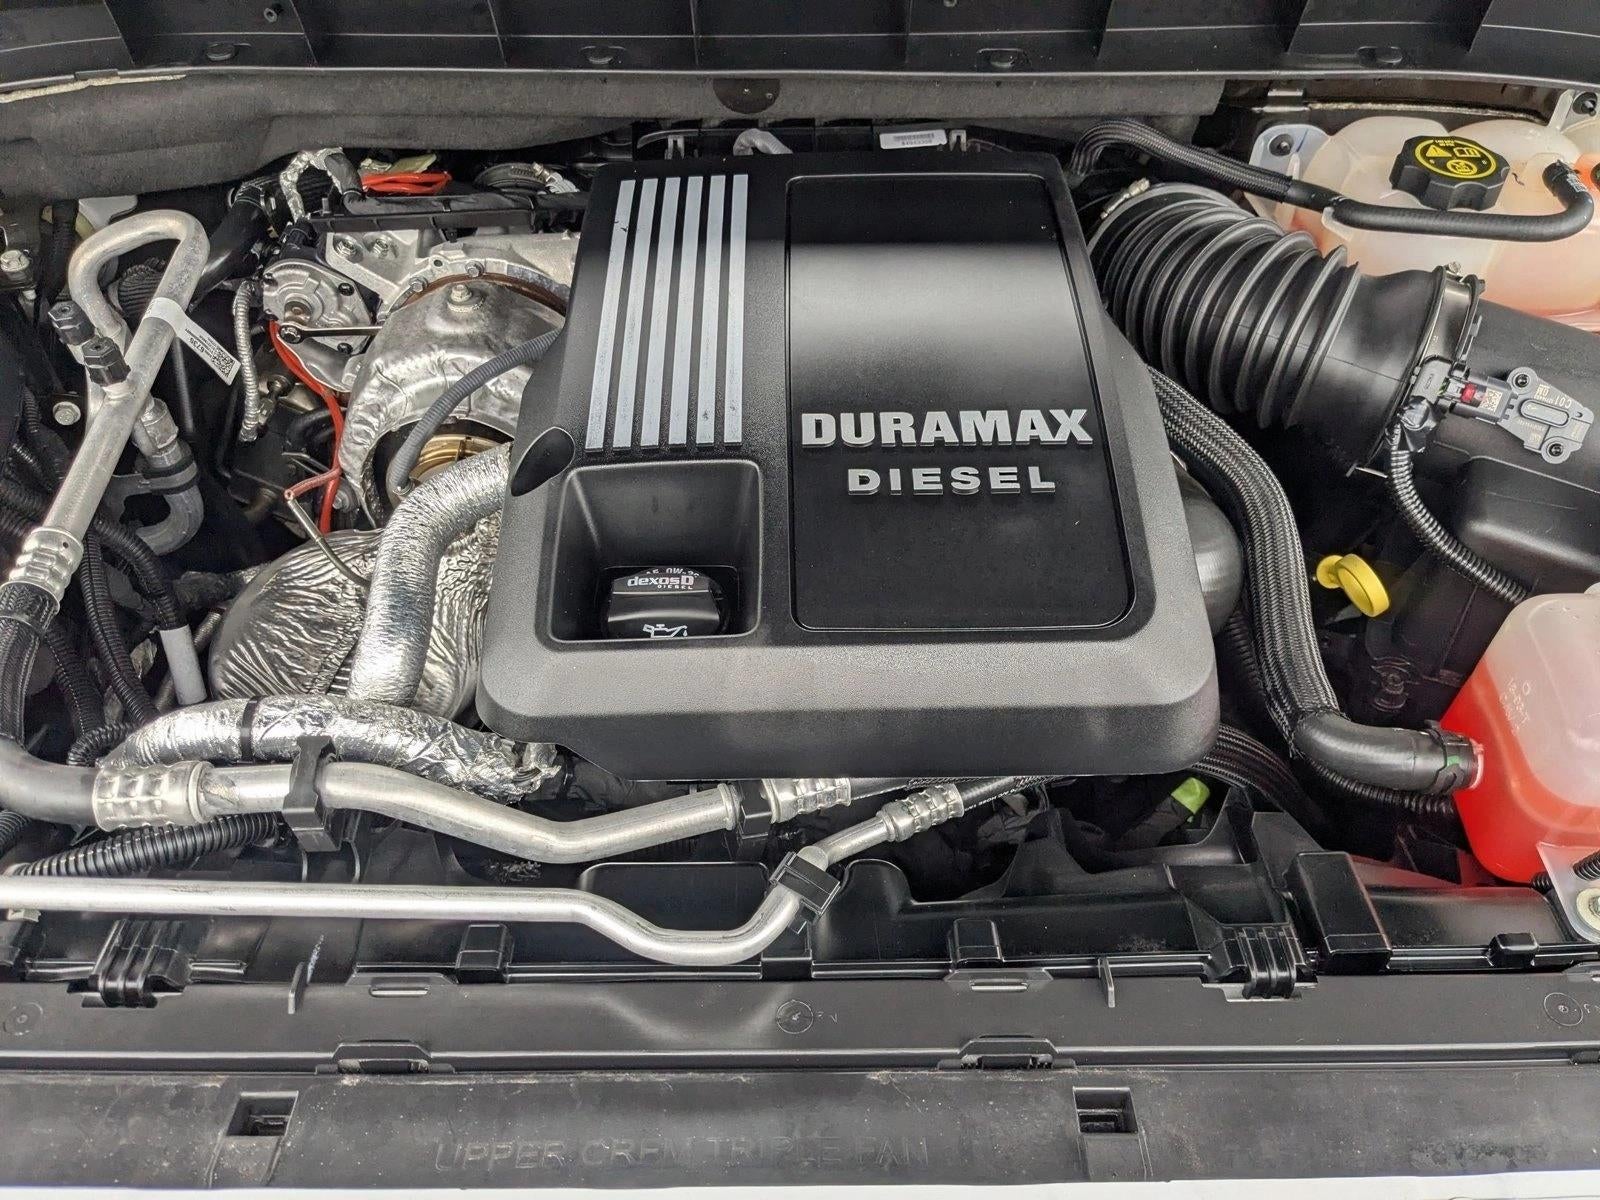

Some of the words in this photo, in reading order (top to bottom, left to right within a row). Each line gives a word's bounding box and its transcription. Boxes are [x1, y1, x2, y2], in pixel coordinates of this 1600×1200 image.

[801, 409, 1093, 447] DURAMAX
[848, 466, 1055, 495] DIESEL
[435, 1140, 566, 1172] UPPER
[704, 1136, 843, 1167] TRIPLE
[858, 1136, 929, 1167] FAN
